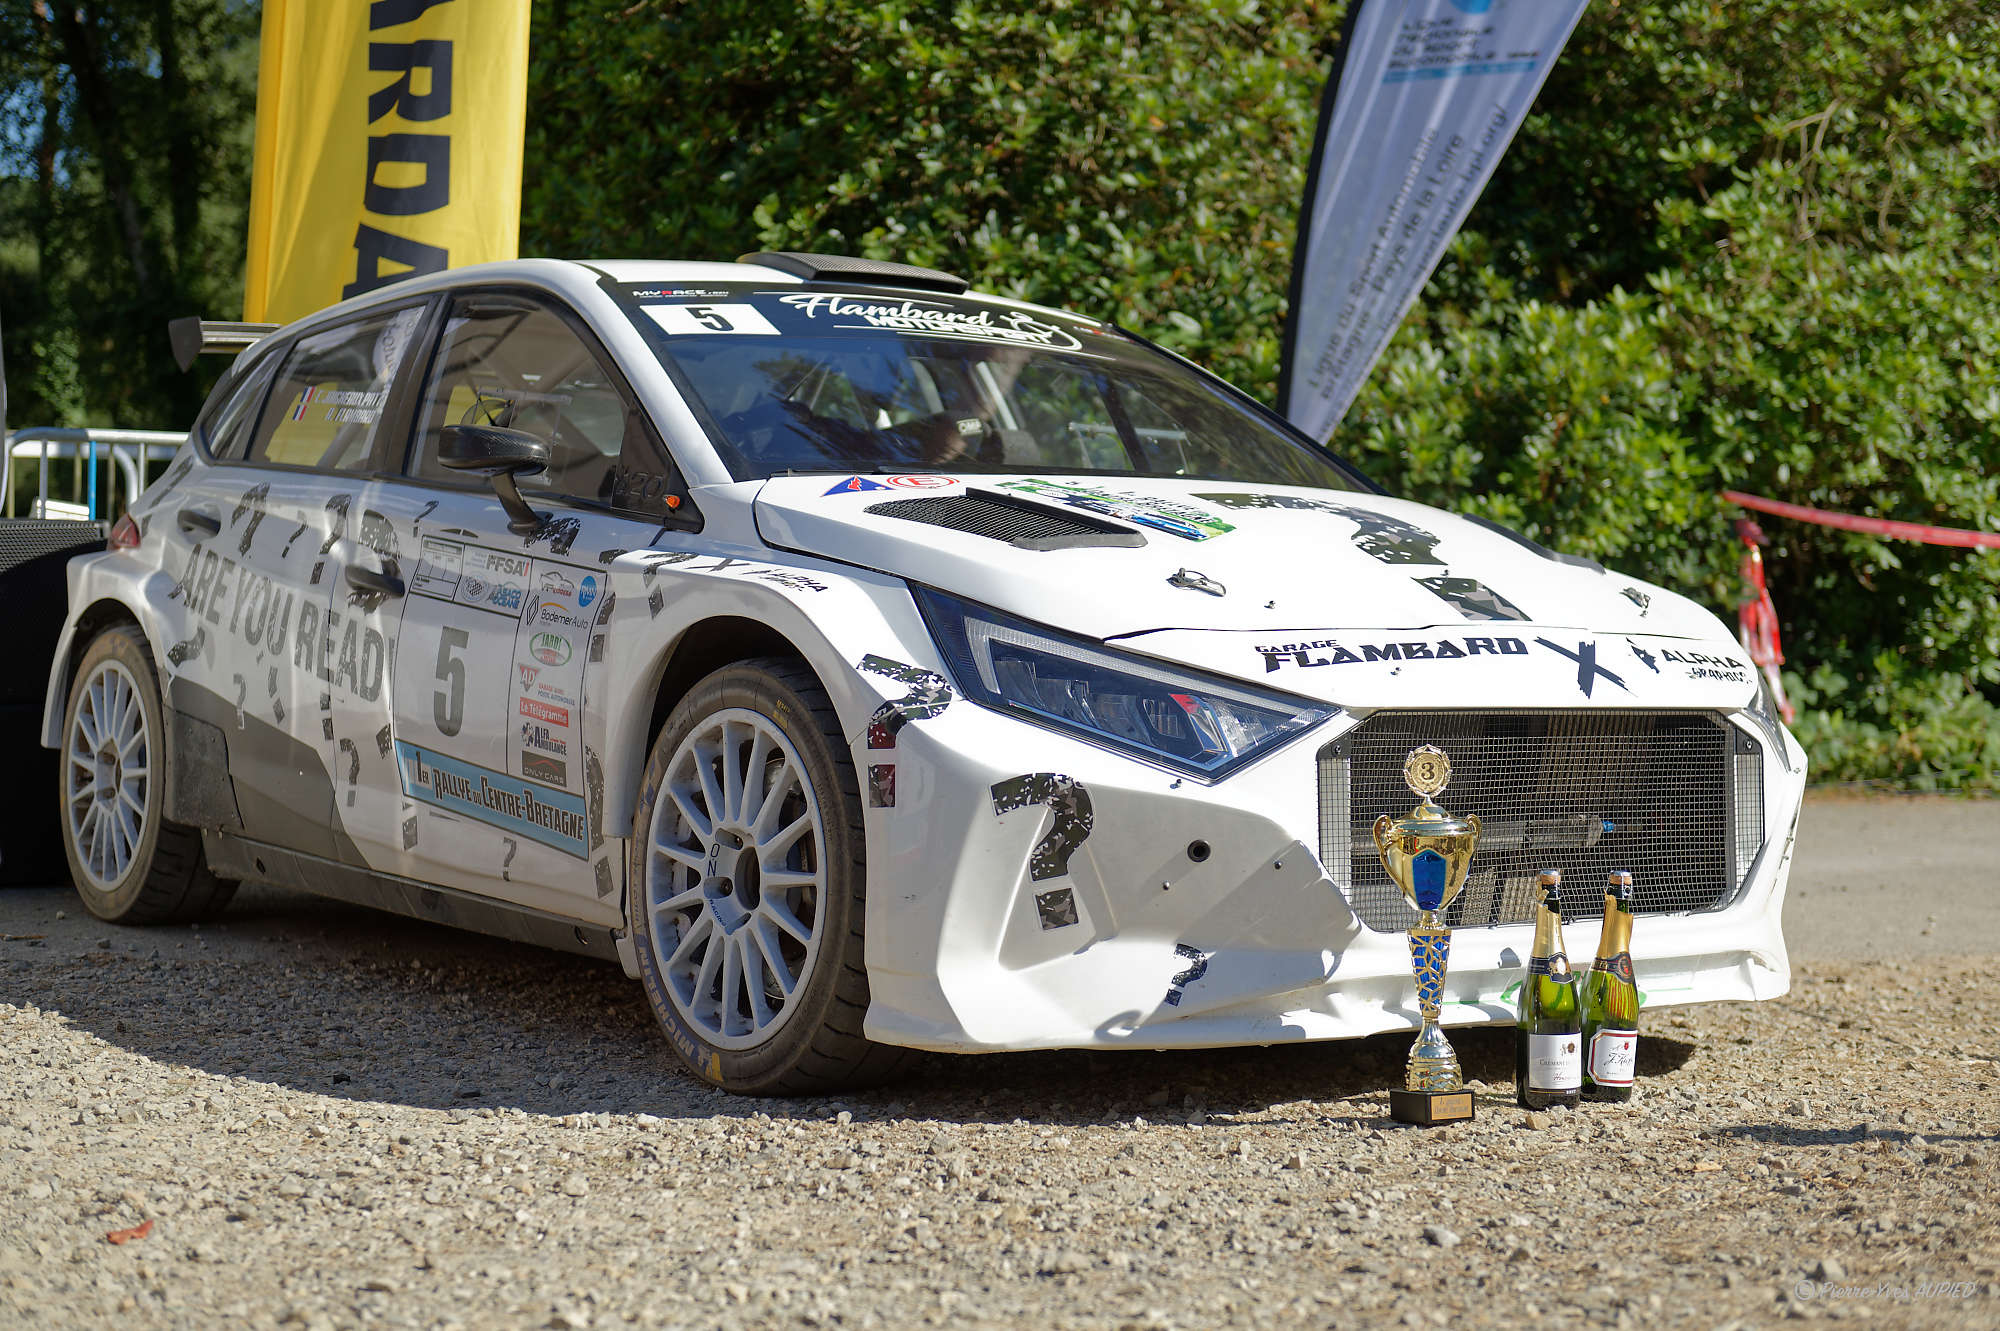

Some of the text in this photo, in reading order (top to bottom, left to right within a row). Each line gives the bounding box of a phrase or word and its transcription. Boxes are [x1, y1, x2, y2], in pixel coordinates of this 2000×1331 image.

[684, 307, 735, 331] 5
[778, 293, 996, 327] Flambard
[184, 544, 396, 704] ARE YOU READ
[1254, 638, 1340, 654] GARAGE
[1261, 637, 1529, 674] FLAMBARD
[1660, 648, 1748, 670] ALPHA
[433, 626, 471, 738] 5
[520, 701, 529, 712] Le
[1420, 761, 1436, 781] 3
[432, 768, 473, 803] RALLYE
[480, 774, 586, 842] CENTRE-BRETAGNE
[638, 946, 696, 1058] MICHELIN
